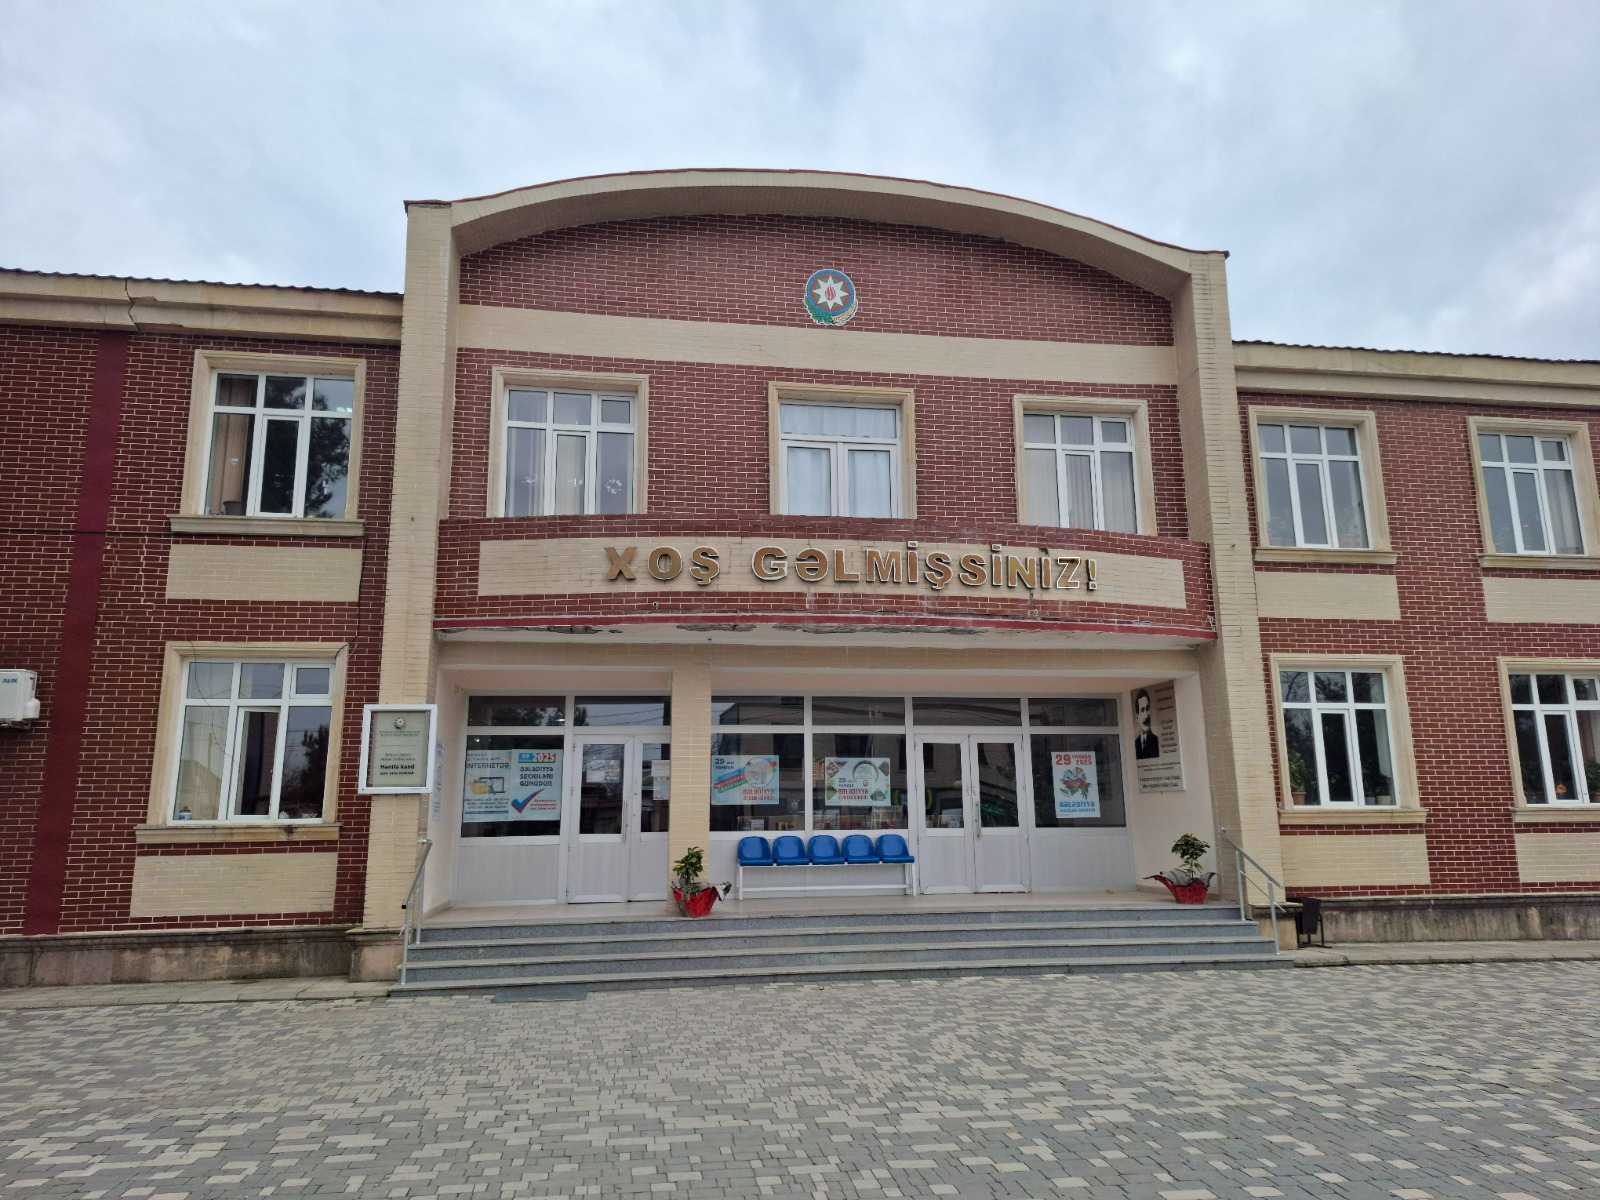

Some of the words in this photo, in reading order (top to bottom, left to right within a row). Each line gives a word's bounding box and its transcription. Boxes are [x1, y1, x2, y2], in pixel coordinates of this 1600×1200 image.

[604, 546, 720, 585] XOŞ
[752, 540, 1098, 591] GƏLMİŞSİNİZ!
[1055, 753, 1072, 766] 29
